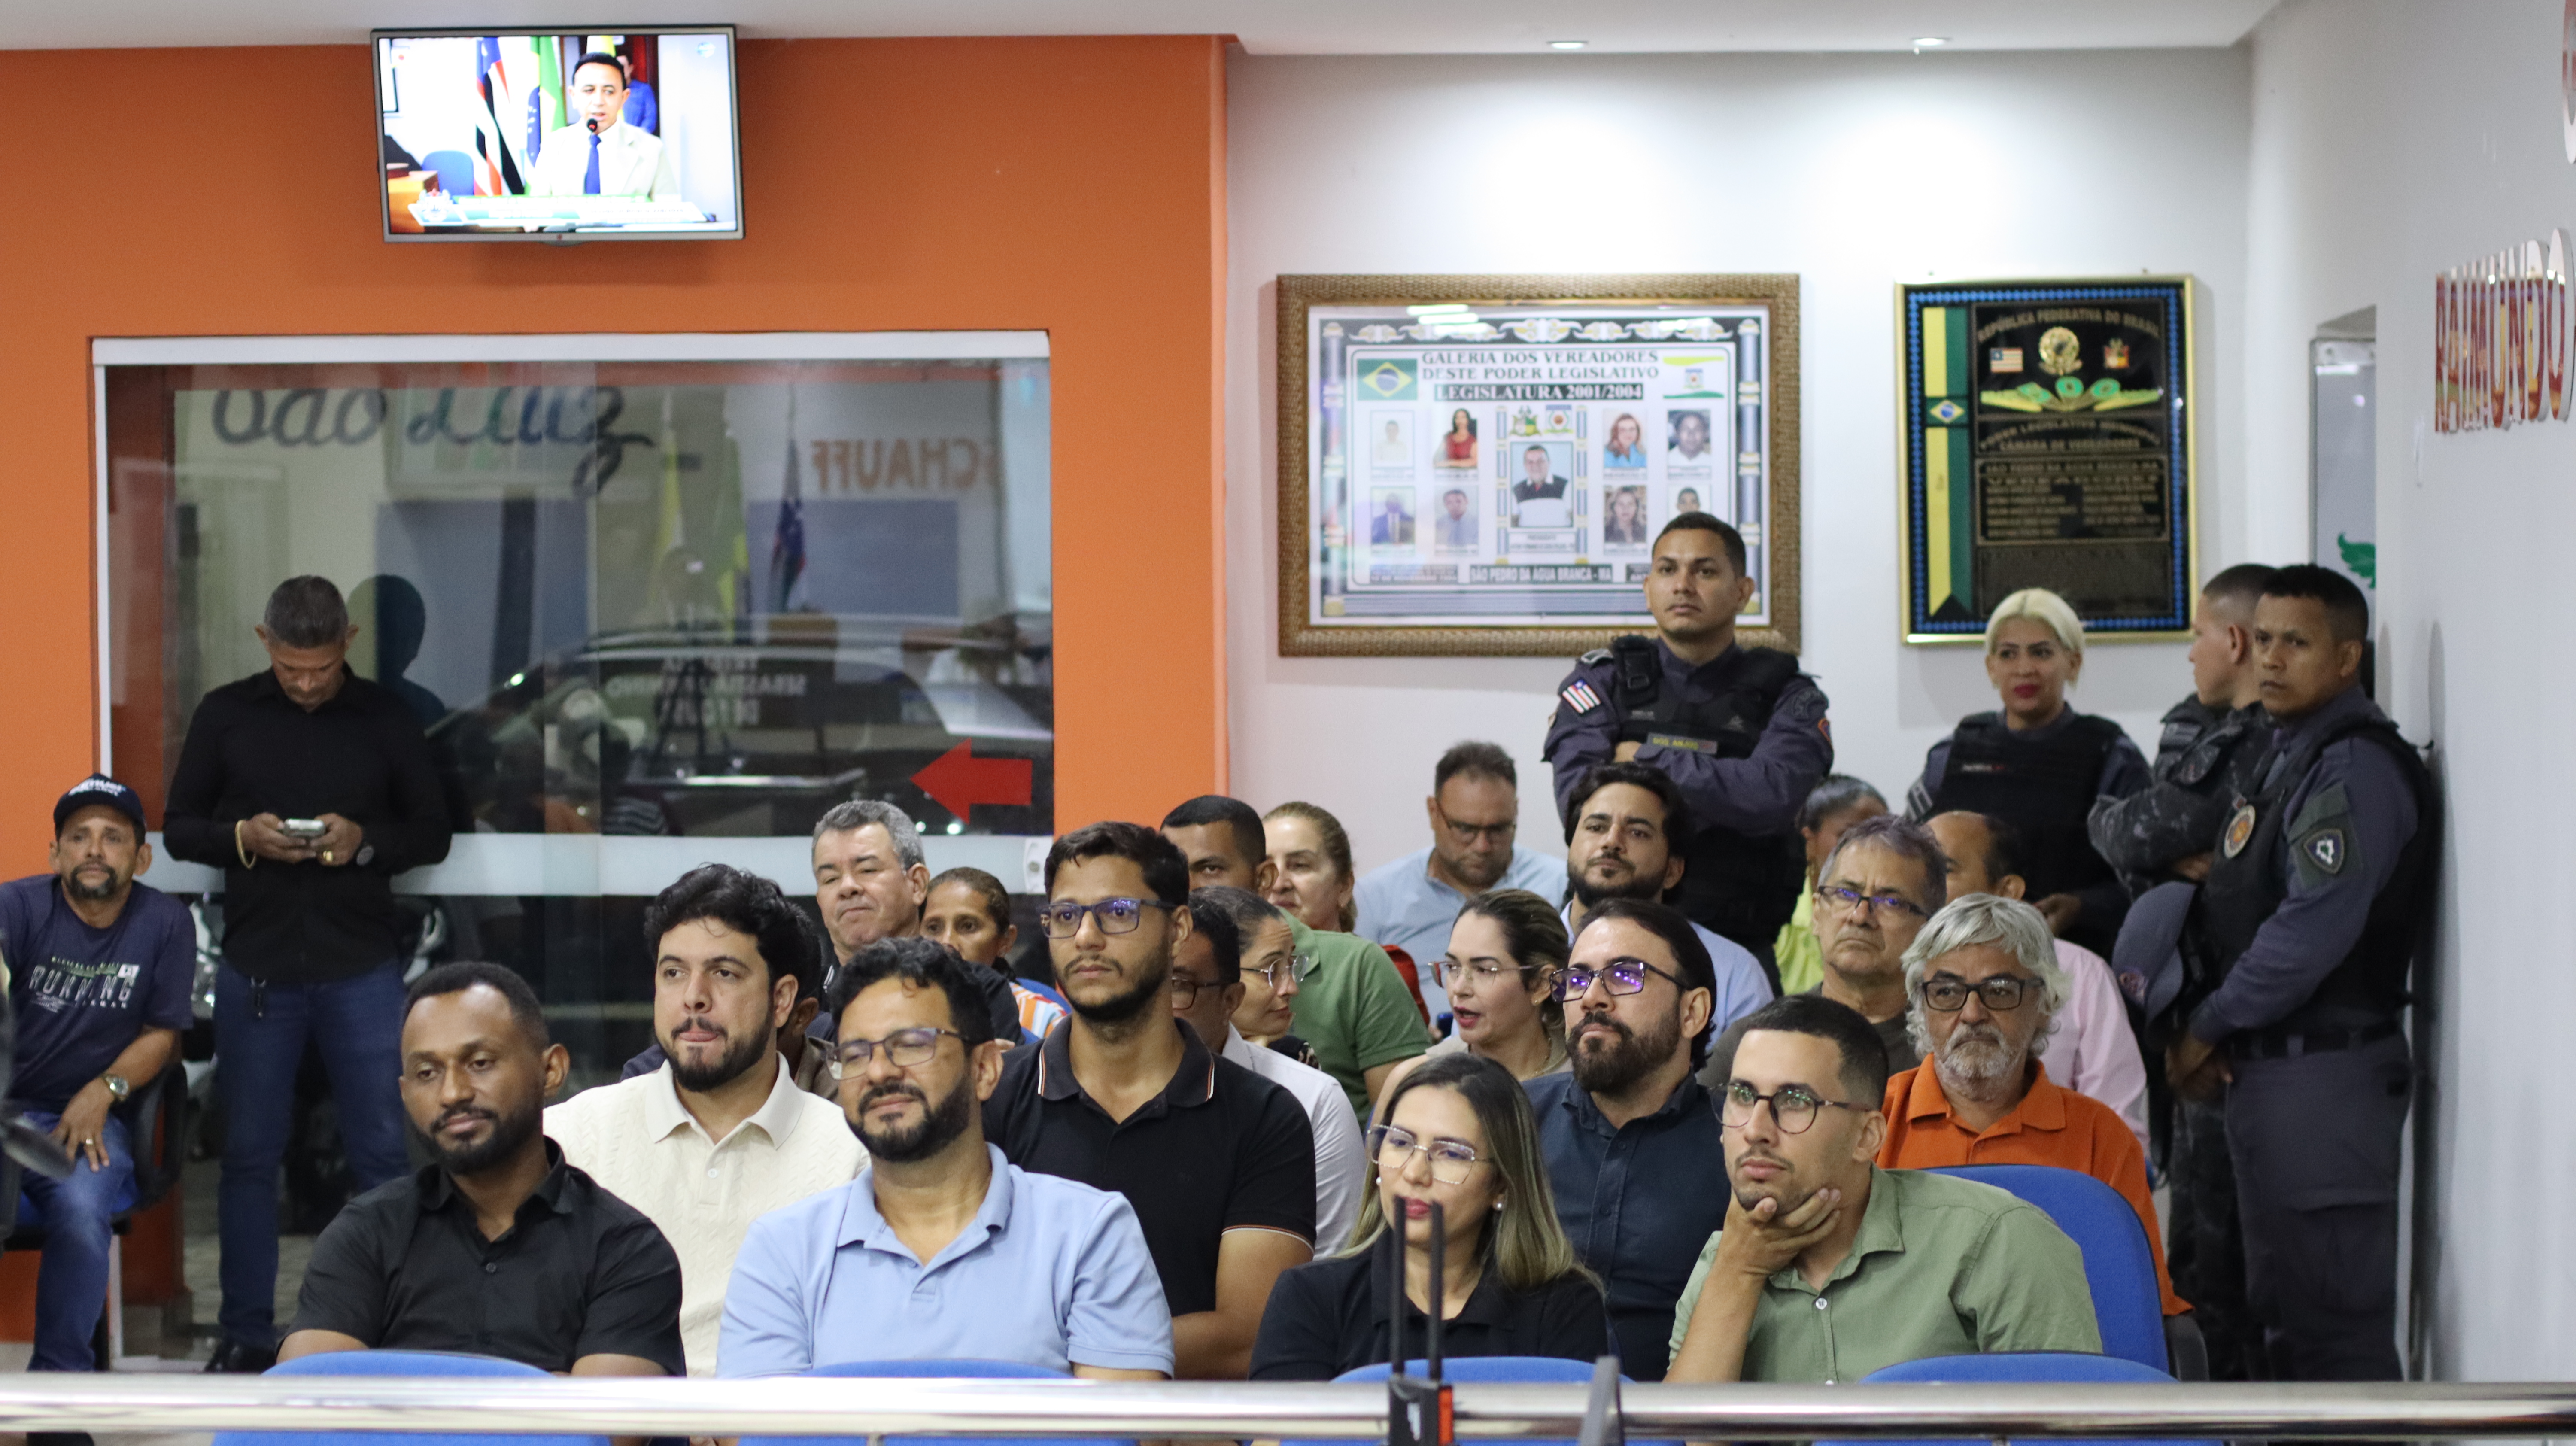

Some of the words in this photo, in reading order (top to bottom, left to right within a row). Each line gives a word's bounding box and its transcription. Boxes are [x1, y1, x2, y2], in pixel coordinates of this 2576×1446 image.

[1422, 351, 1496, 365] GALERIA
[1503, 350, 1538, 364] DOS
[1545, 350, 1659, 364] VEREADORES
[1422, 367, 1476, 380] DESTE
[1484, 367, 1542, 380] PODER
[1549, 366, 1658, 379] LEGISLATIVO
[1437, 386, 1563, 401] LEGISLATURA
[1566, 385, 1643, 400] 2001/2004
